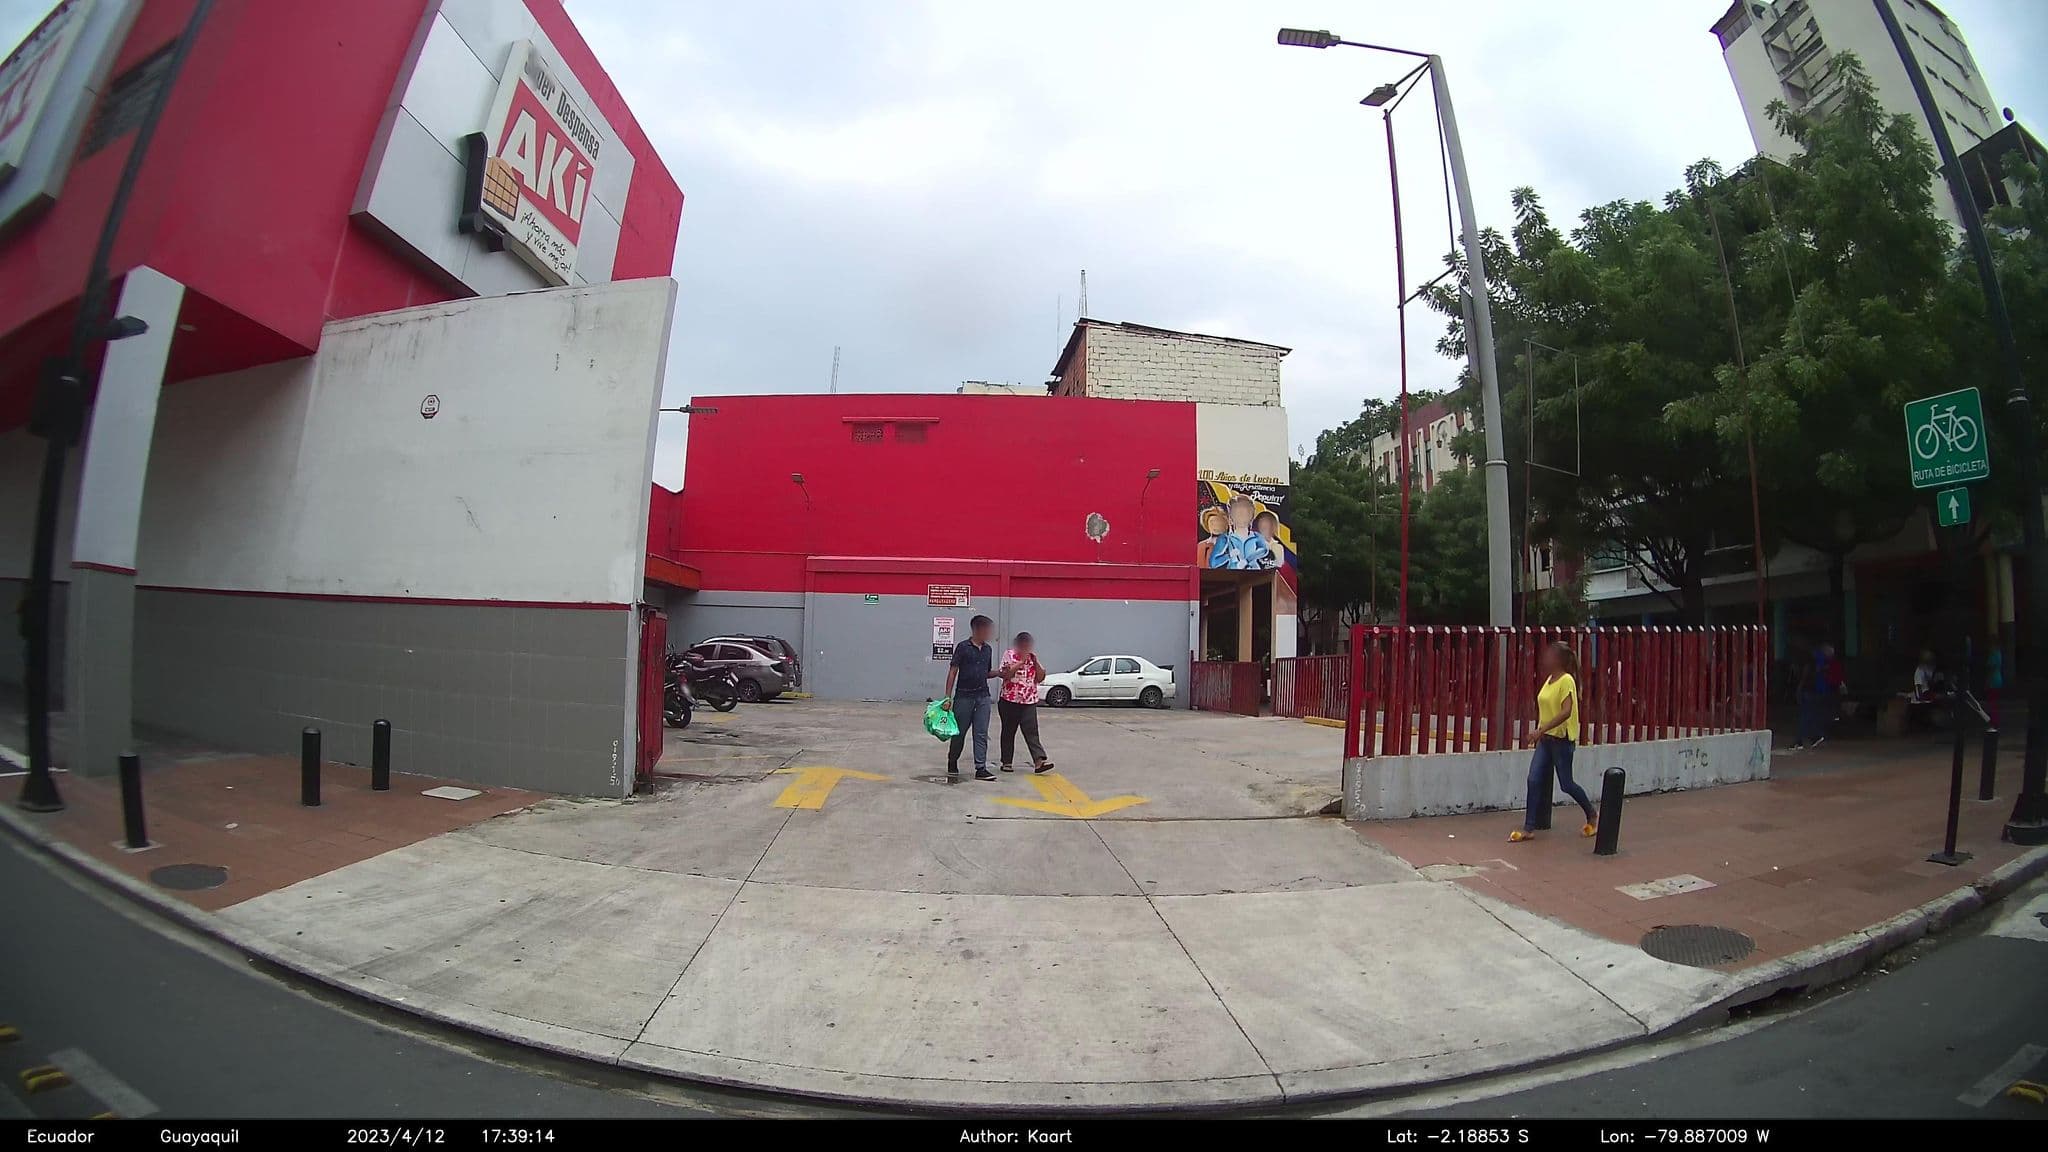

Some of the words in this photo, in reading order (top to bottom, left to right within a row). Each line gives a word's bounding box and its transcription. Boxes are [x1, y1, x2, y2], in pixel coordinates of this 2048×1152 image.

[556, 90, 600, 161] Despensa
[525, 232, 533, 243] y
[534, 238, 547, 253] vive
[1914, 469, 1934, 481] RUTA
[1935, 466, 1946, 477] DE
[1946, 460, 1986, 475] BICICLETA
